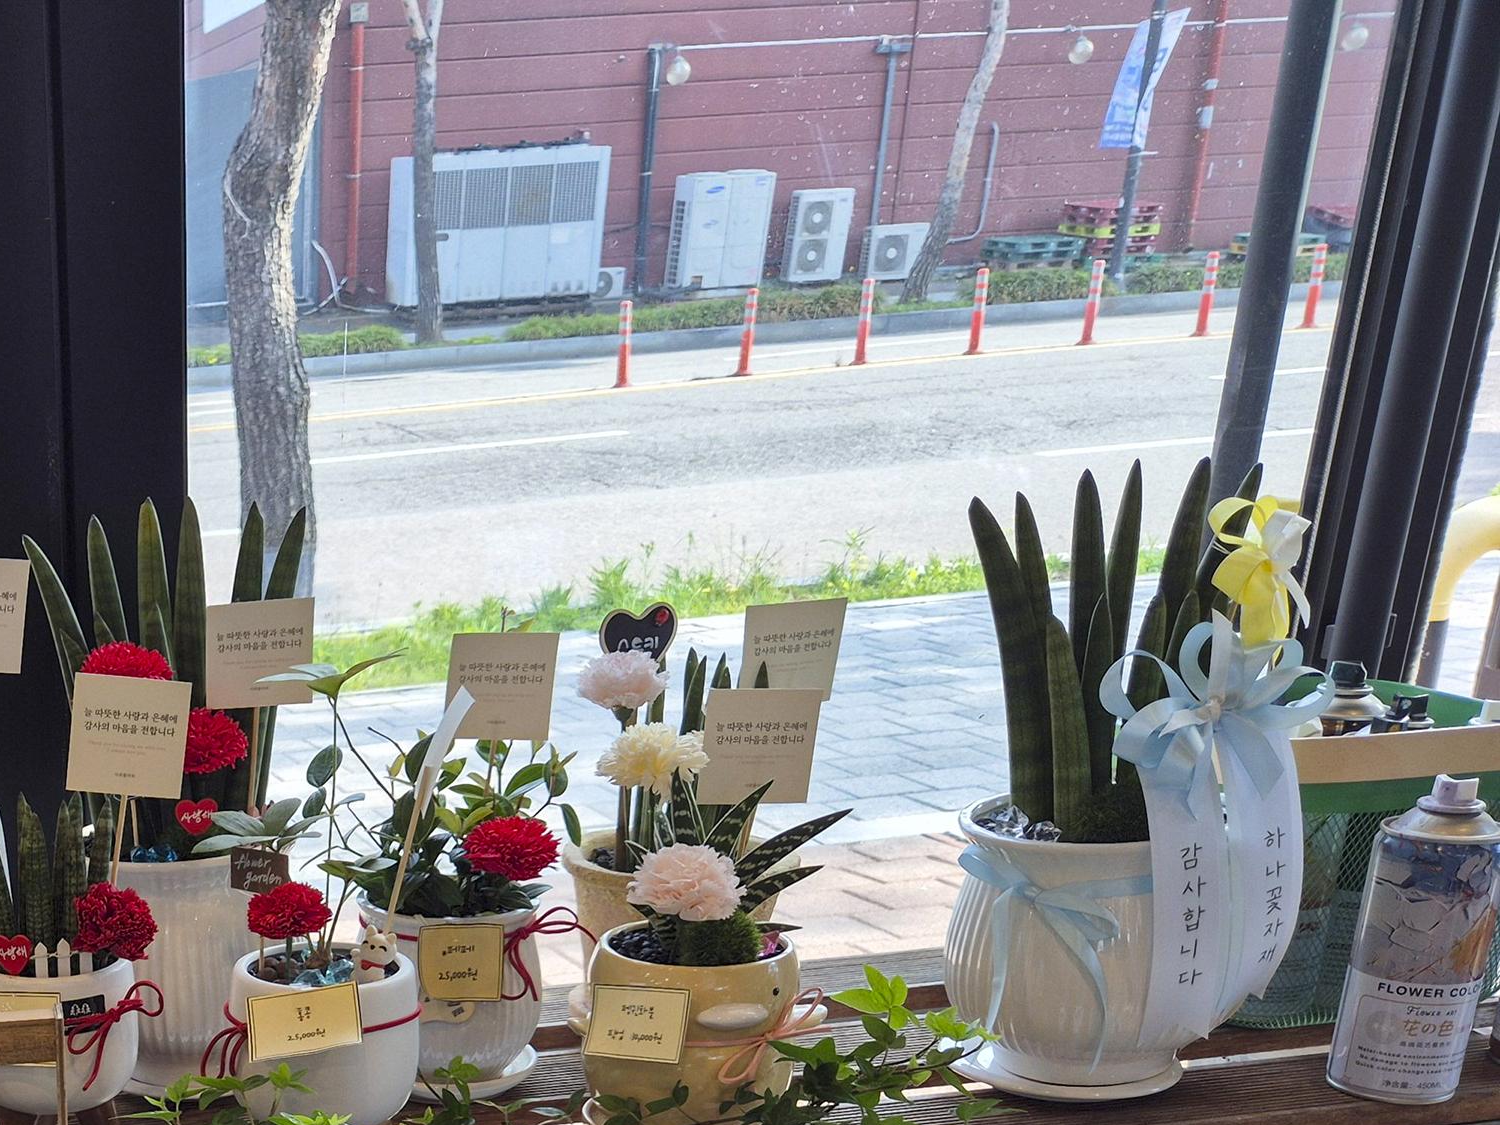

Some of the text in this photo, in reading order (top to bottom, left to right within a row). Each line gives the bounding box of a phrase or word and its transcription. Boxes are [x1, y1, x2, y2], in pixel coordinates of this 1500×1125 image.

[84, 707, 178, 724] 늘 따뜻한 사랑과 은혜에
[84, 720, 176, 737] 감사의 마음을 전합니다
[716, 721, 808, 732] 늘 따뜻한 사랑과 은혜에
[716, 734, 805, 746] 감사의 마음을 전합니다
[244, 867, 282, 890] garden
[1258, 826, 1286, 963] 하나꽃자재
[1178, 842, 1206, 985] 감사합니다
[439, 968, 478, 981] 25,000원
[1378, 982, 1444, 998] FLOWER
[1406, 1005, 1440, 1016] FLOWER
[287, 1028, 325, 1041] 25,000원
[1403, 1020, 1454, 1037] 花の色
